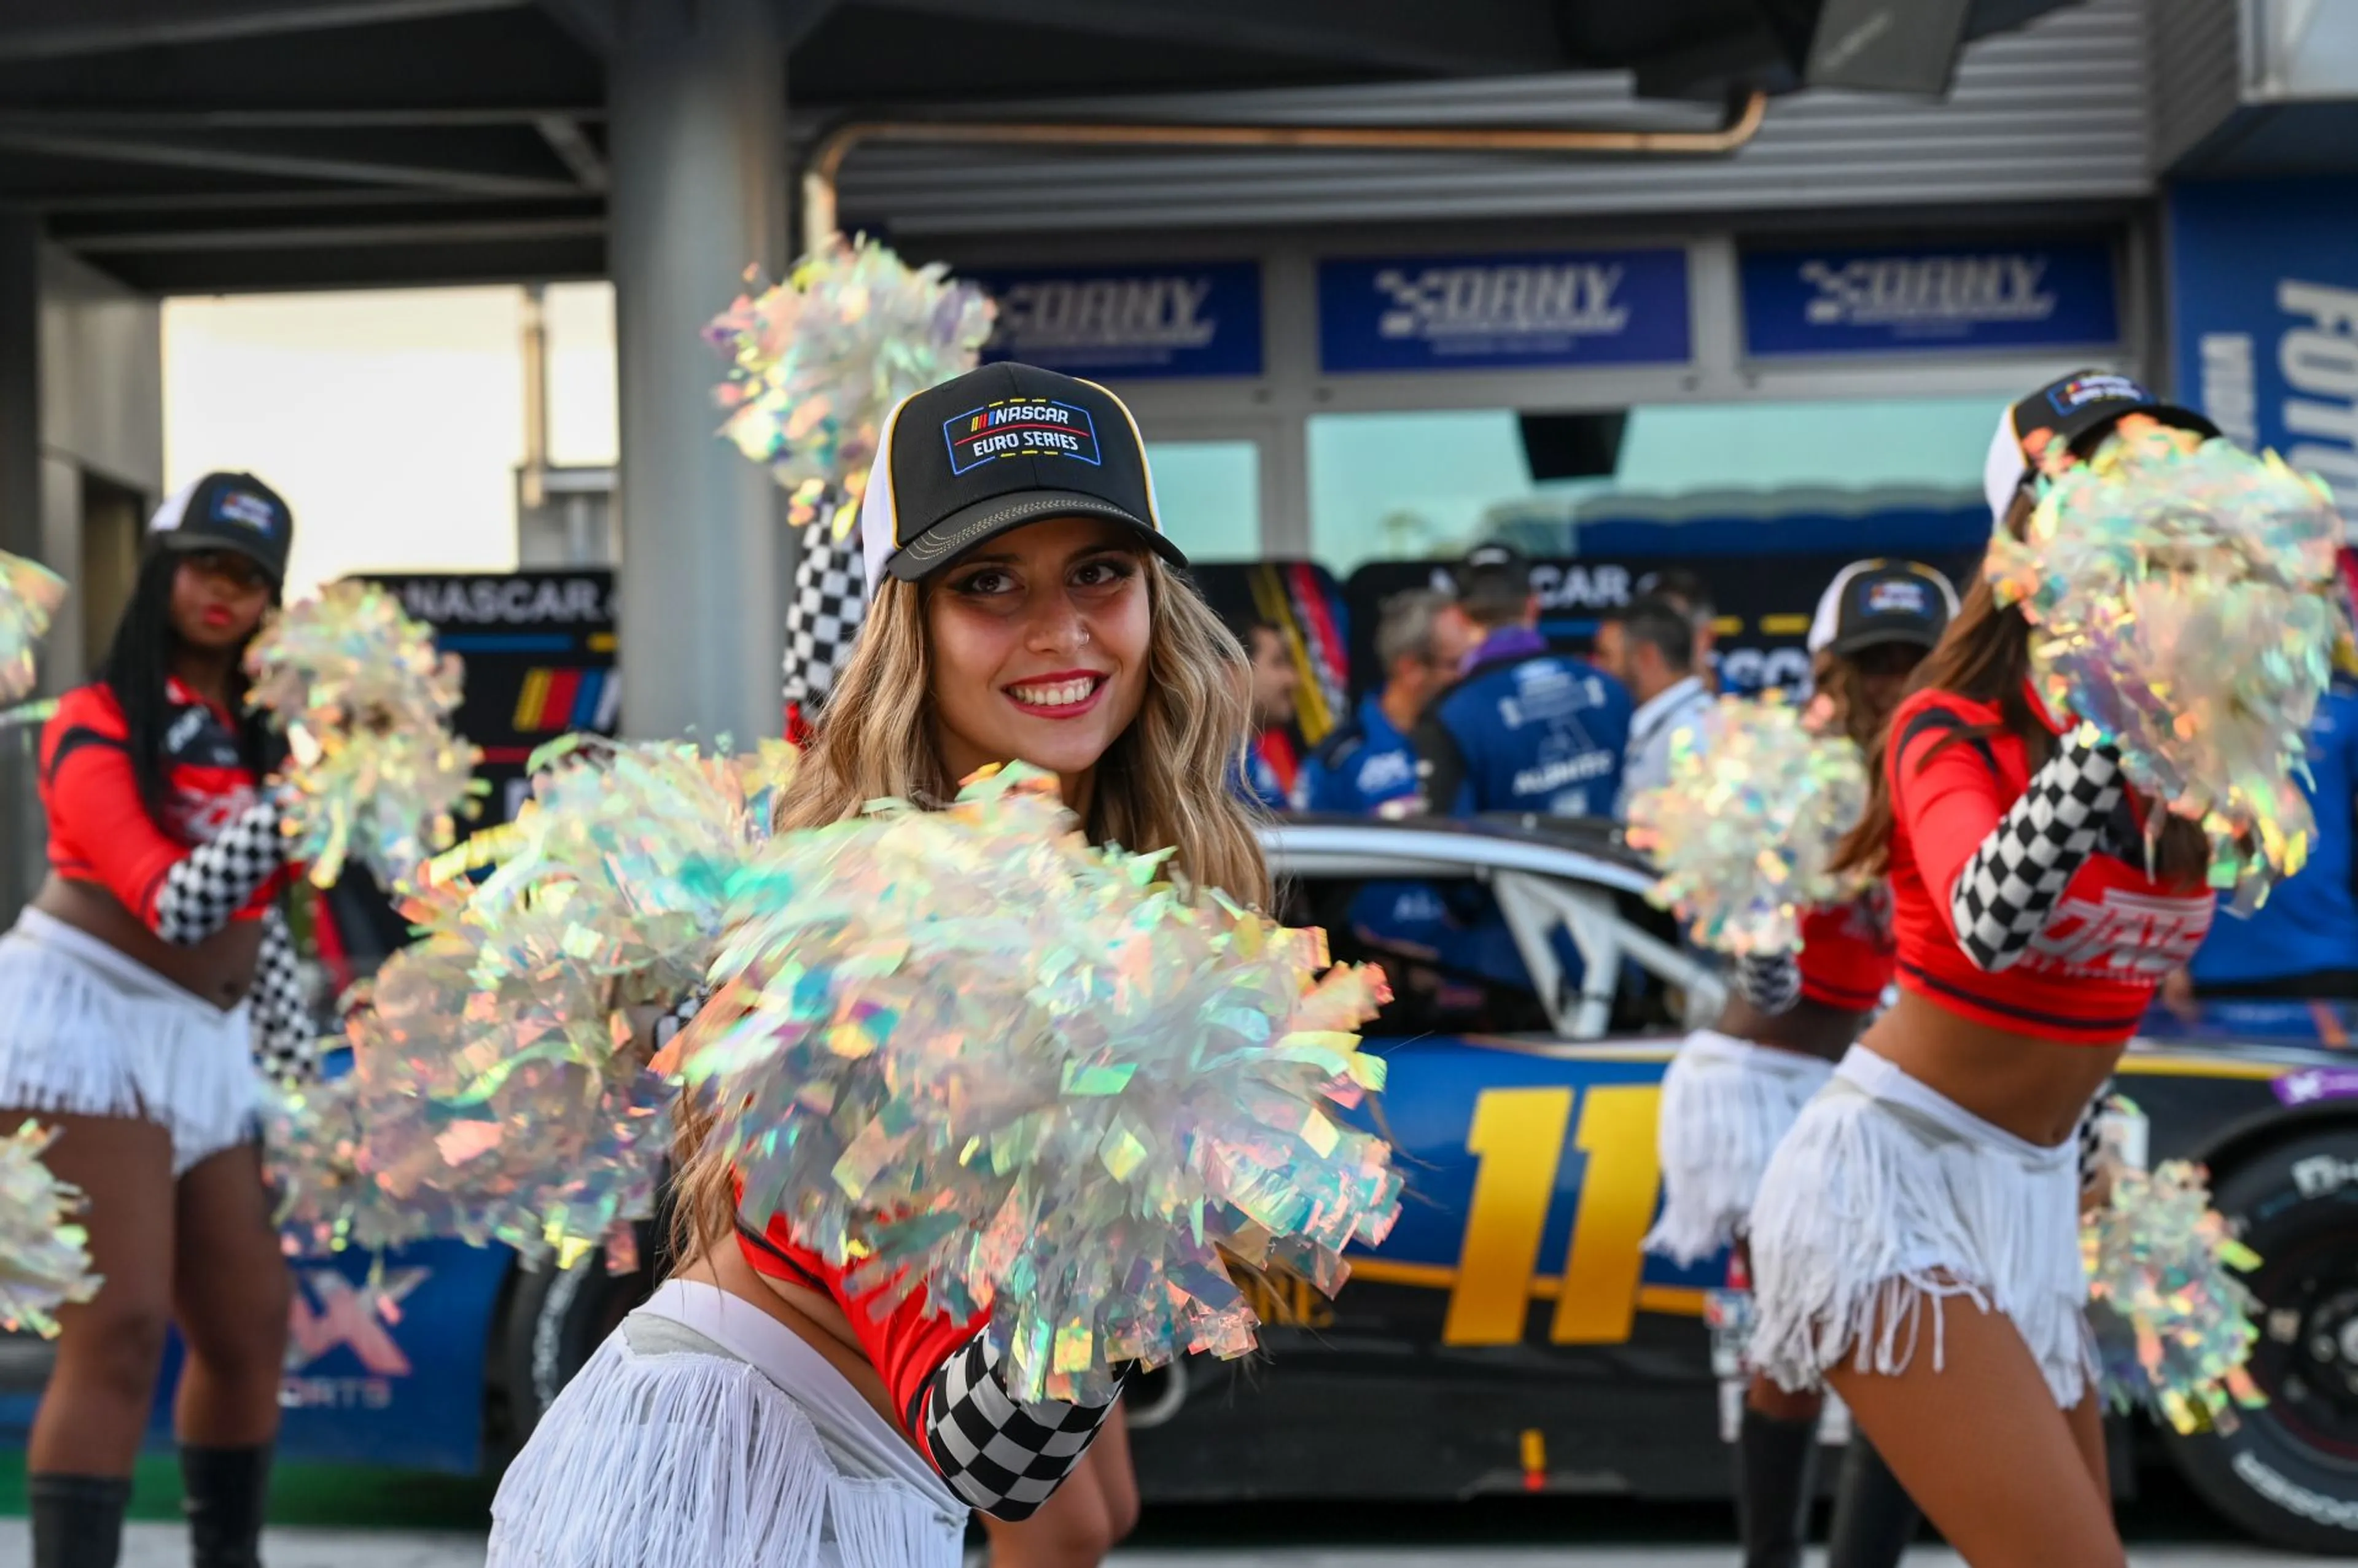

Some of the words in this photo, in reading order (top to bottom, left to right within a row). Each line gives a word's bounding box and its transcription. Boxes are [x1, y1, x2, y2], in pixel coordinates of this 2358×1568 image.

[996, 406, 1068, 424] NASCAR
[973, 432, 1019, 457] EURO
[1022, 432, 1078, 450] SERIES
[1442, 1084, 1661, 1345] 11
